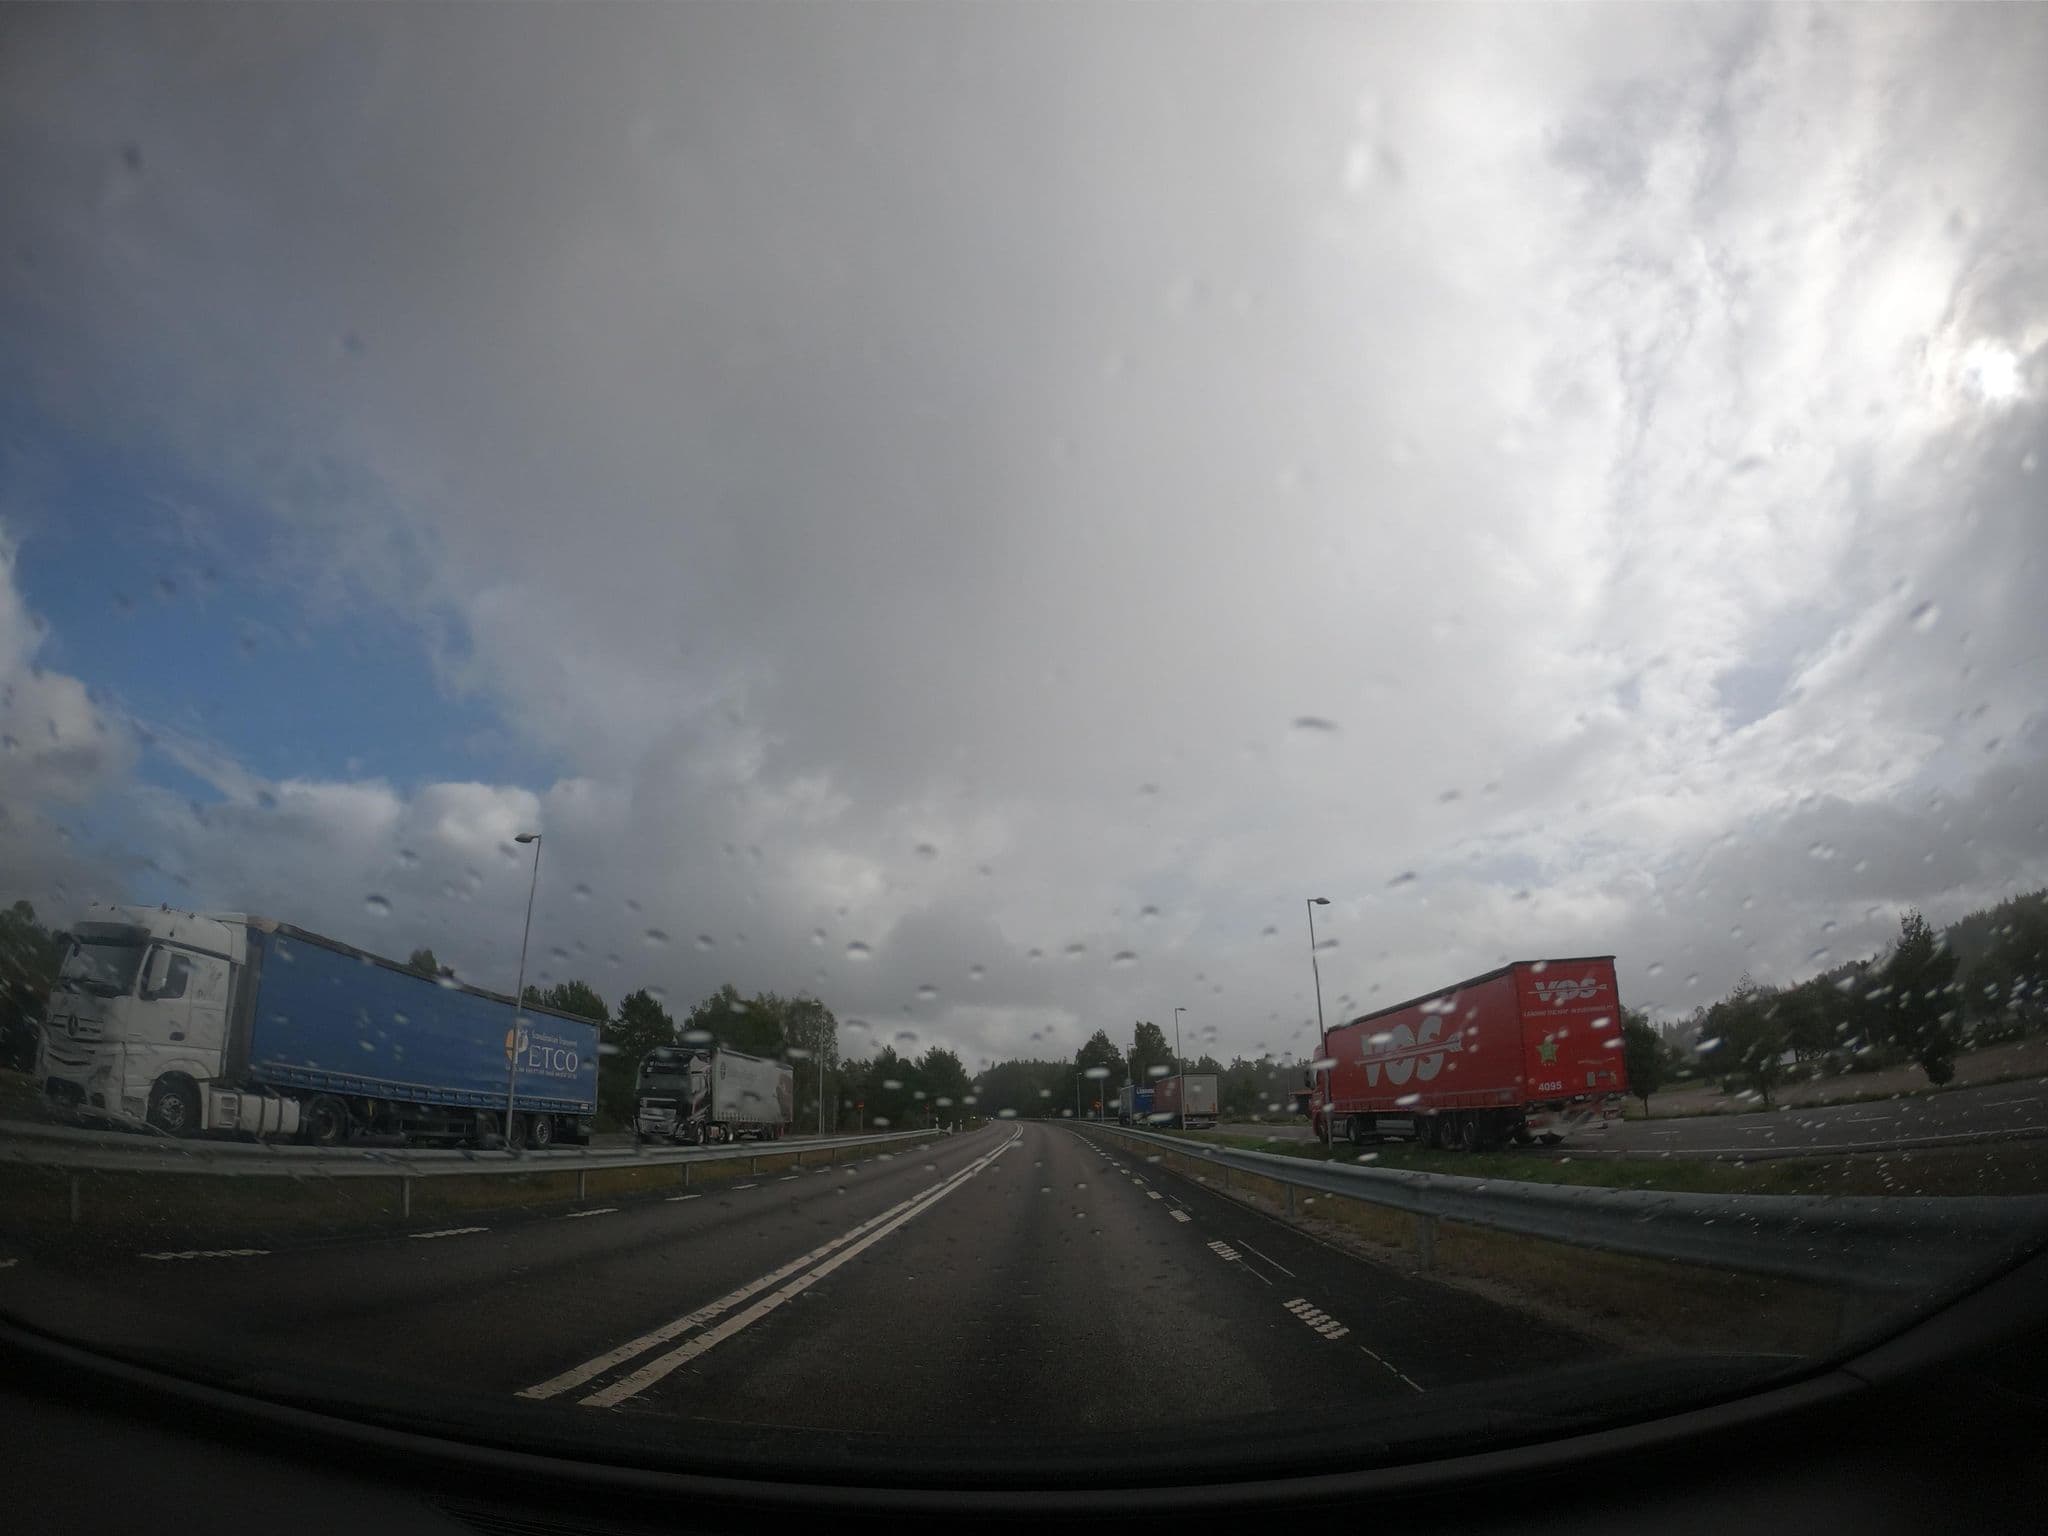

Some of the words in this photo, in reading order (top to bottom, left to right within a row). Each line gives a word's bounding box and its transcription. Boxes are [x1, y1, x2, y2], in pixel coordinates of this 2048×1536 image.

[1534, 977, 1597, 1002] VOS
[513, 1028, 578, 1073] PETCO
[1361, 1015, 1444, 1087] VOS
[1538, 1081, 1562, 1092] 4095
